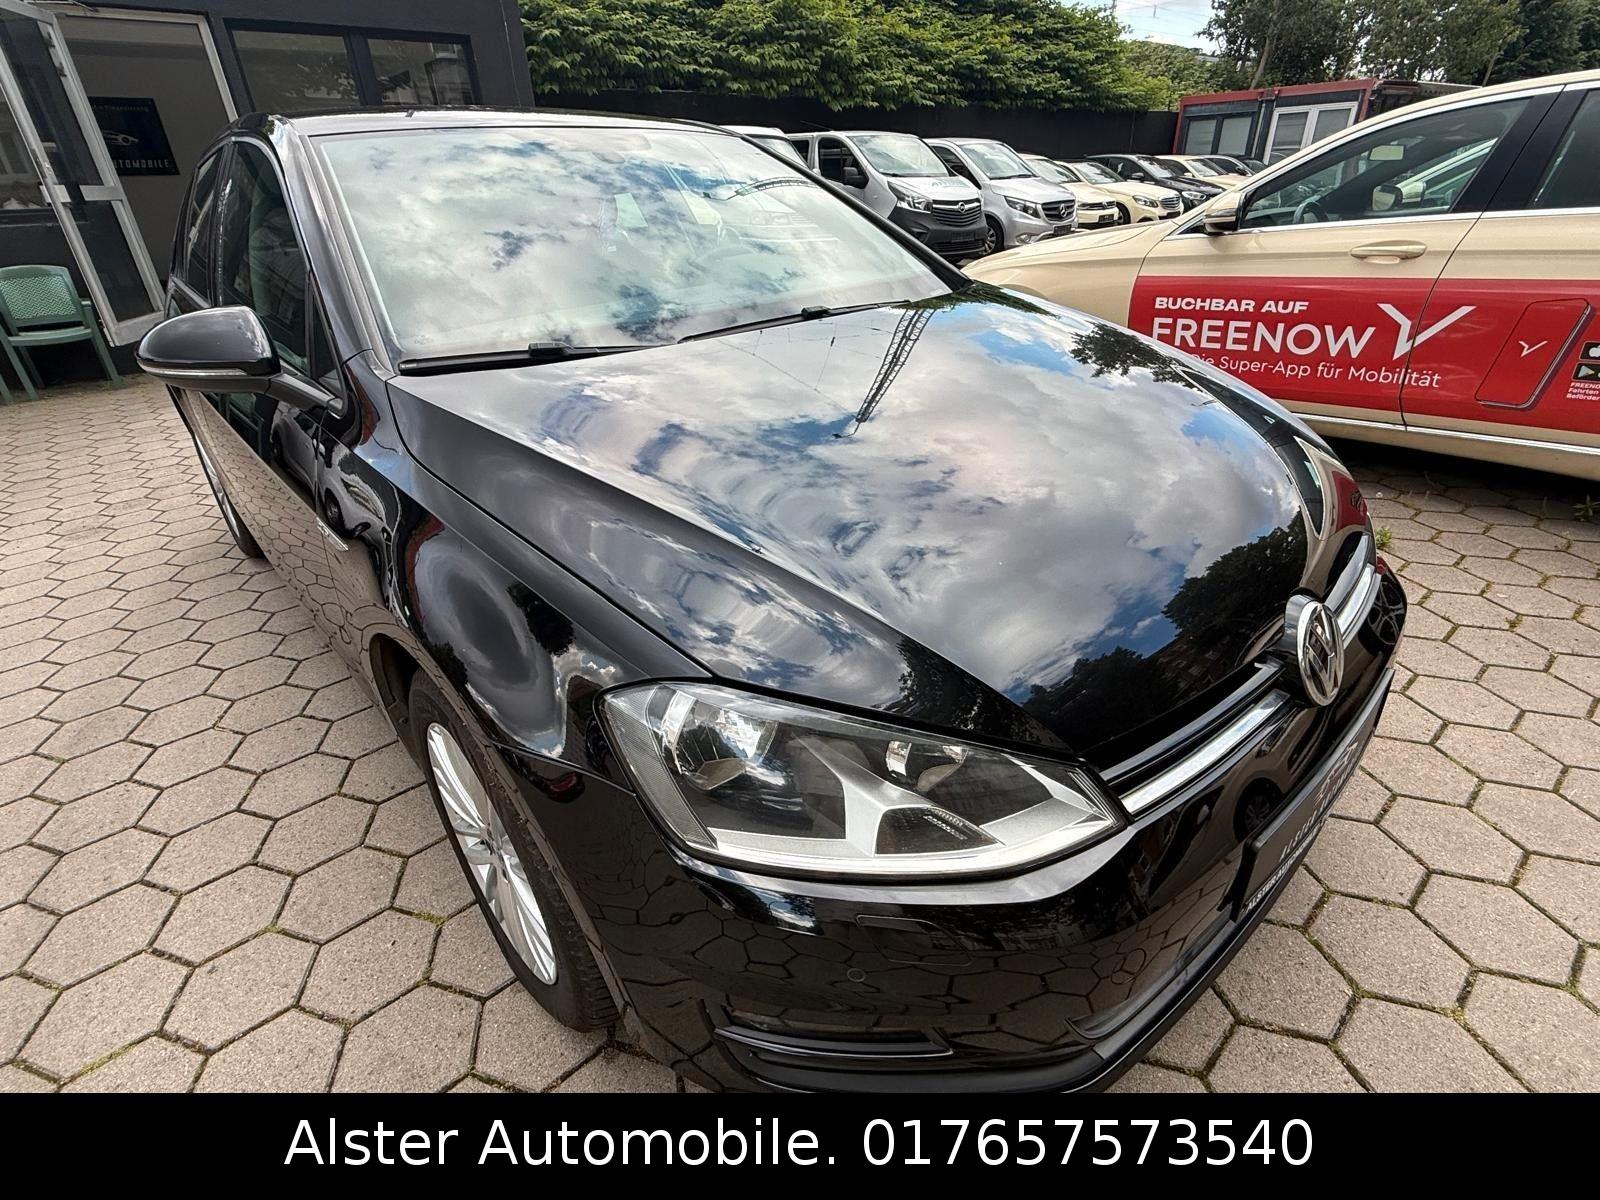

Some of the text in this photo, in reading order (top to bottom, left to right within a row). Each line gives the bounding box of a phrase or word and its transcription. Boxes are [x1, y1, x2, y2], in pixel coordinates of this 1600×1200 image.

[1154, 296, 1310, 314] BUCHBAR AUF
[1152, 316, 1377, 359] FREENOW
[1219, 355, 1311, 379] Super-App
[1316, 361, 1343, 379] für
[1347, 365, 1442, 388] Mobilität
